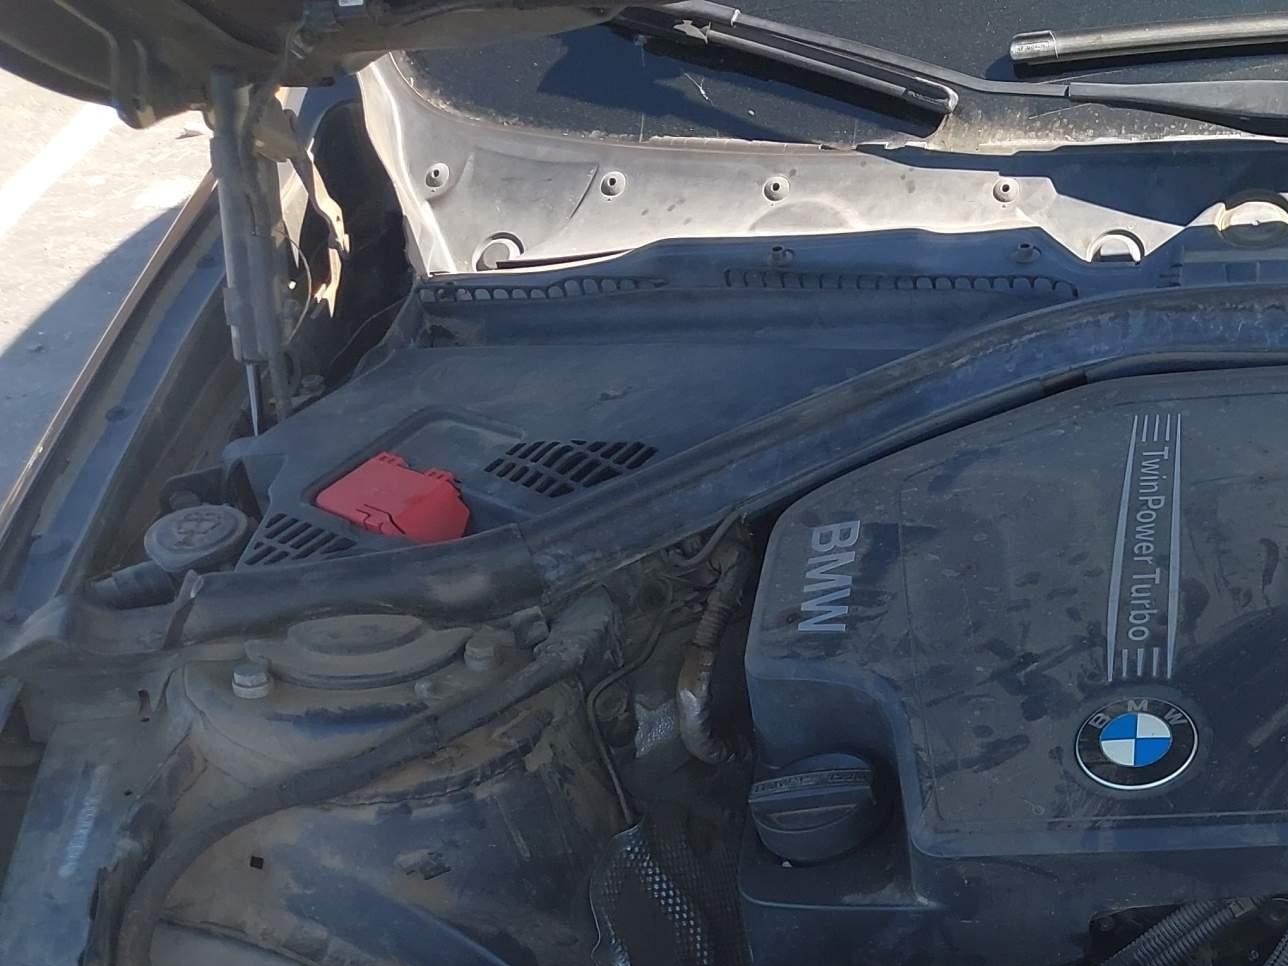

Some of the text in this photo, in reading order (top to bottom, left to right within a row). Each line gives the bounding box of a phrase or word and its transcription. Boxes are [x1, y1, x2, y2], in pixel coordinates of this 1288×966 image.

[797, 520, 860, 632] BMW
[1127, 446, 1169, 641] TwinPower Turbo
[1088, 699, 1187, 729] BMW
